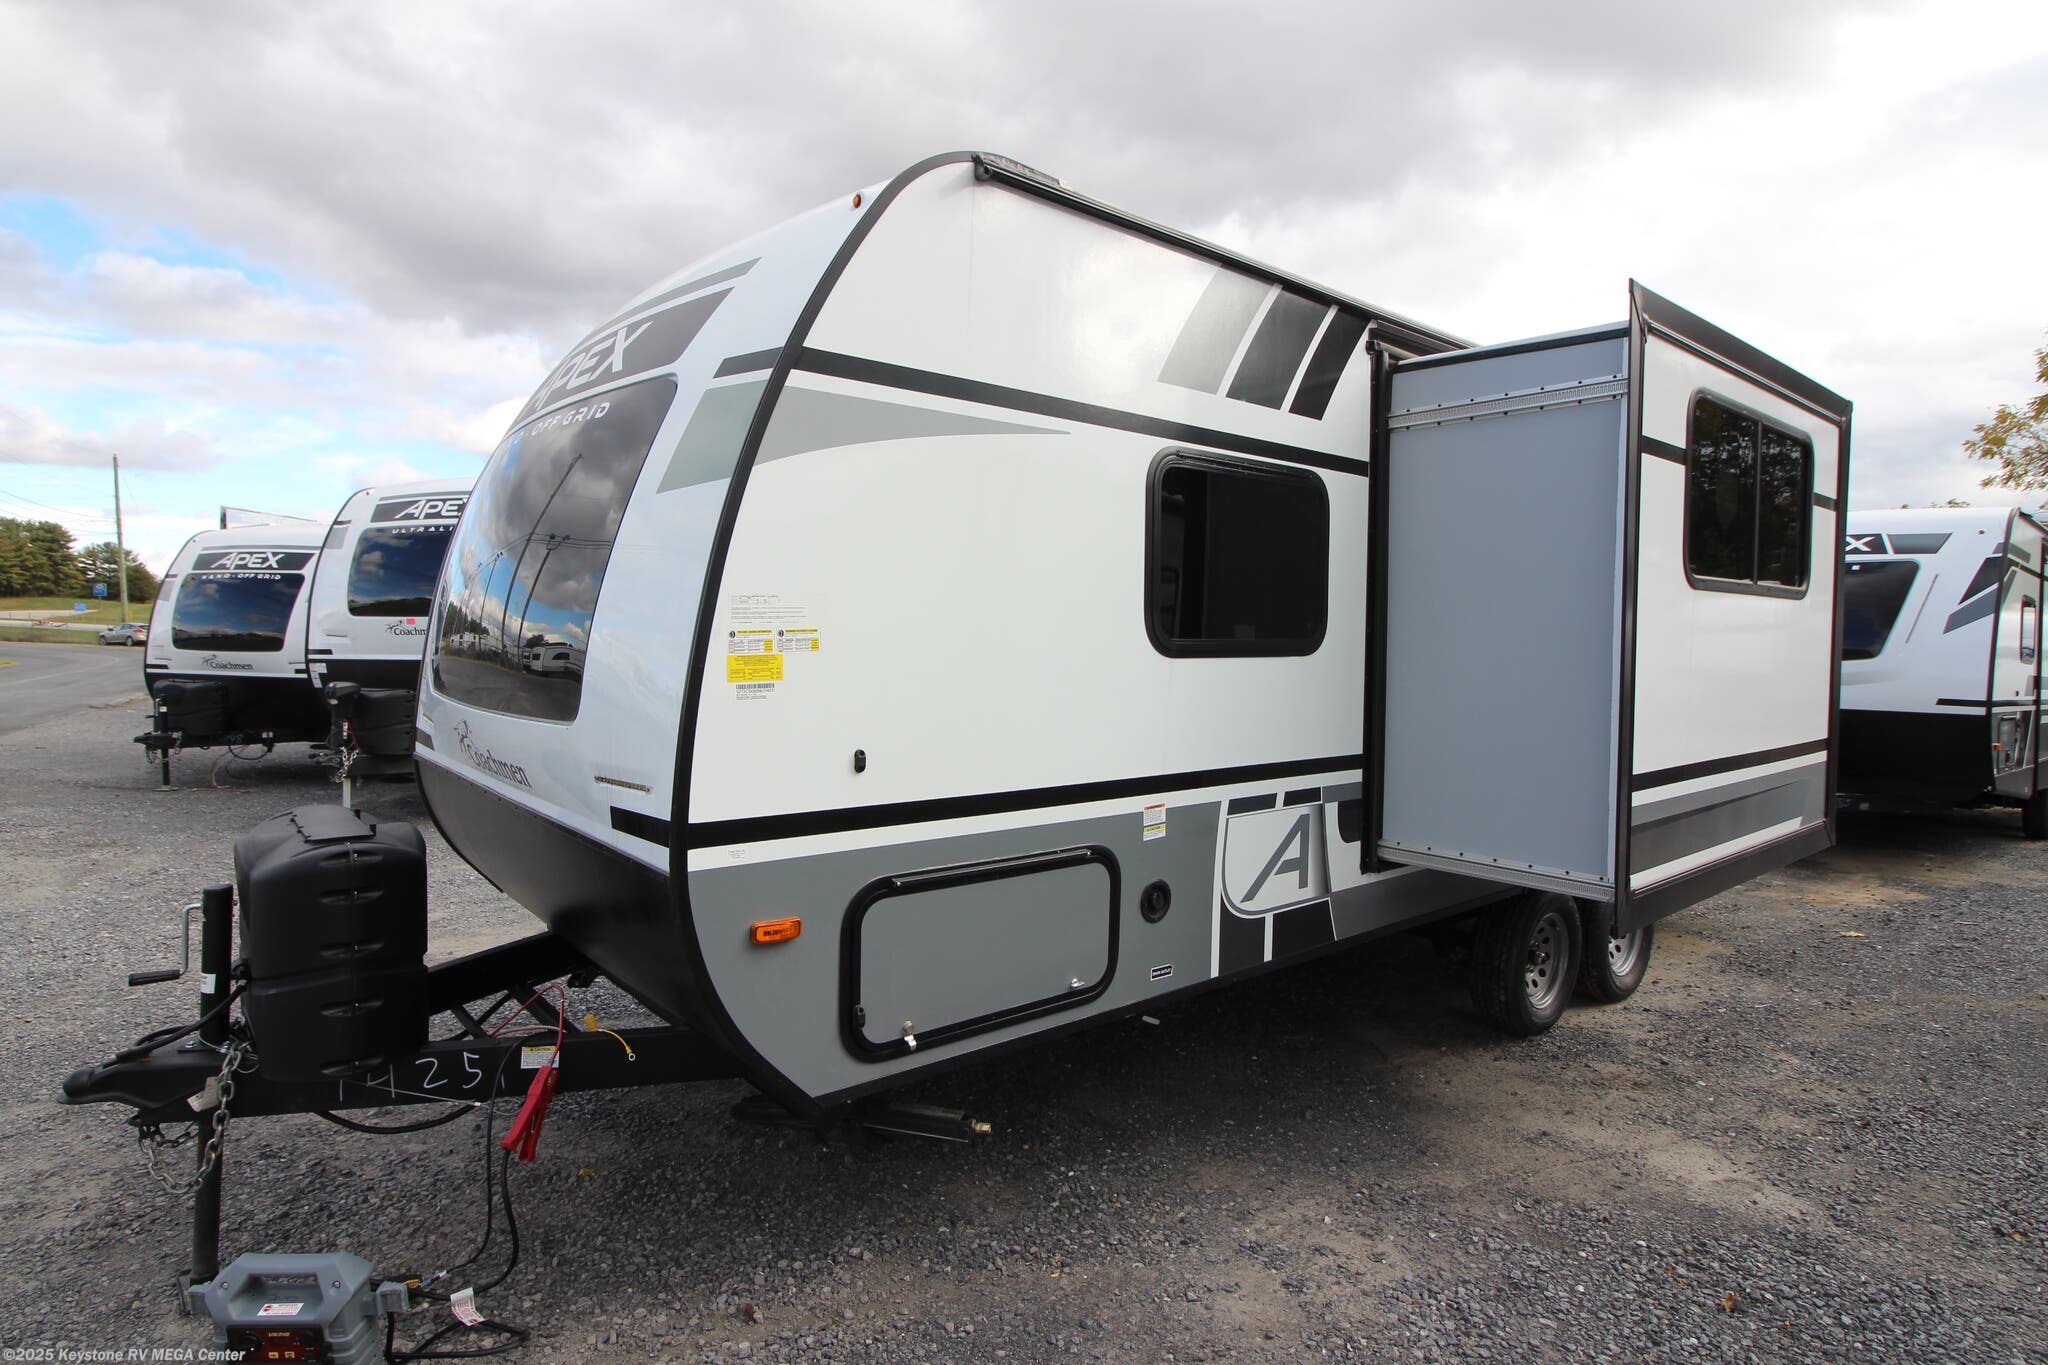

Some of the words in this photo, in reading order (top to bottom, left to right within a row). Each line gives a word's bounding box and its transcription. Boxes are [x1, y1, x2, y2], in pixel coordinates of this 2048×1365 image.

[519, 321, 653, 417] APEX
[531, 415, 560, 436] OFF
[562, 402, 610, 425] GRID
[393, 497, 468, 520] APE
[210, 552, 285, 570] APEX
[210, 660, 254, 671] Coachmen
[467, 744, 532, 788] Coachmen
[1240, 813, 1310, 903] A
